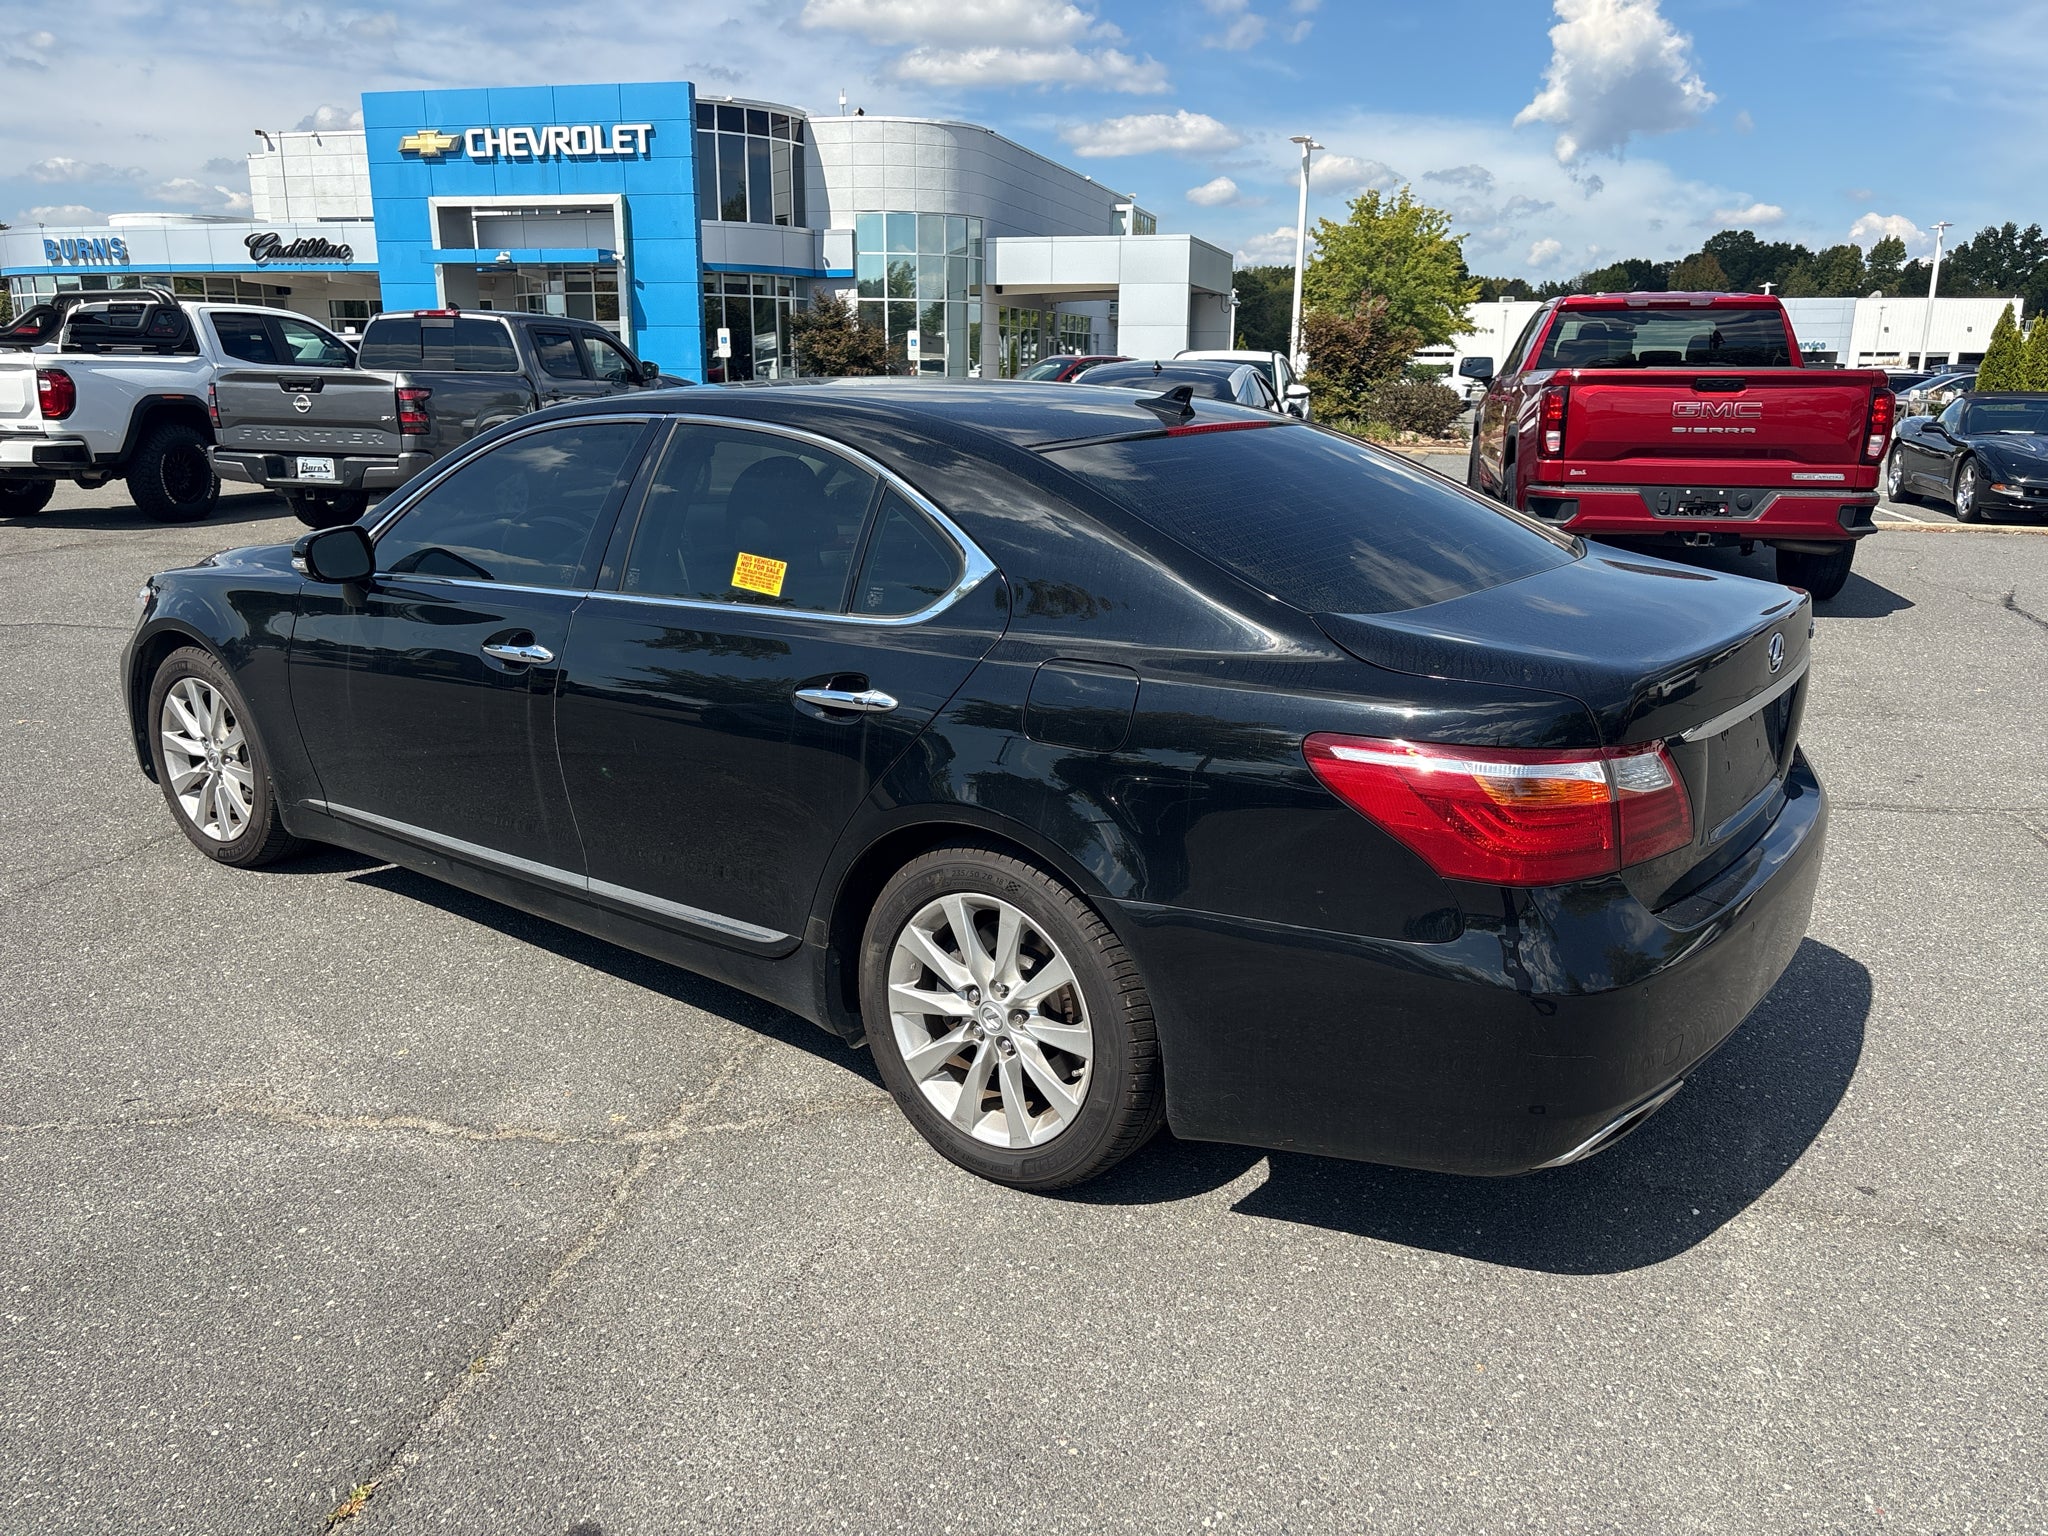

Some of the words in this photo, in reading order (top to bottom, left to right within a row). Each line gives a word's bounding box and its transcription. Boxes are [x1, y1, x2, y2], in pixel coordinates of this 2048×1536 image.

[465, 124, 653, 157] CHEVROLET
[43, 237, 128, 262] BURNS
[244, 232, 352, 263] Cadillac
[1672, 401, 1762, 418] GMC
[238, 428, 385, 445] FRONTIER
[740, 554, 753, 562] THIS
[754, 557, 777, 568] VEHICLE
[766, 566, 781, 575] SALE
[952, 869, 980, 879] 235/50
[982, 872, 993, 881] ZR
[995, 877, 1004, 885] 18
[963, 1152, 987, 1168] SPORT
